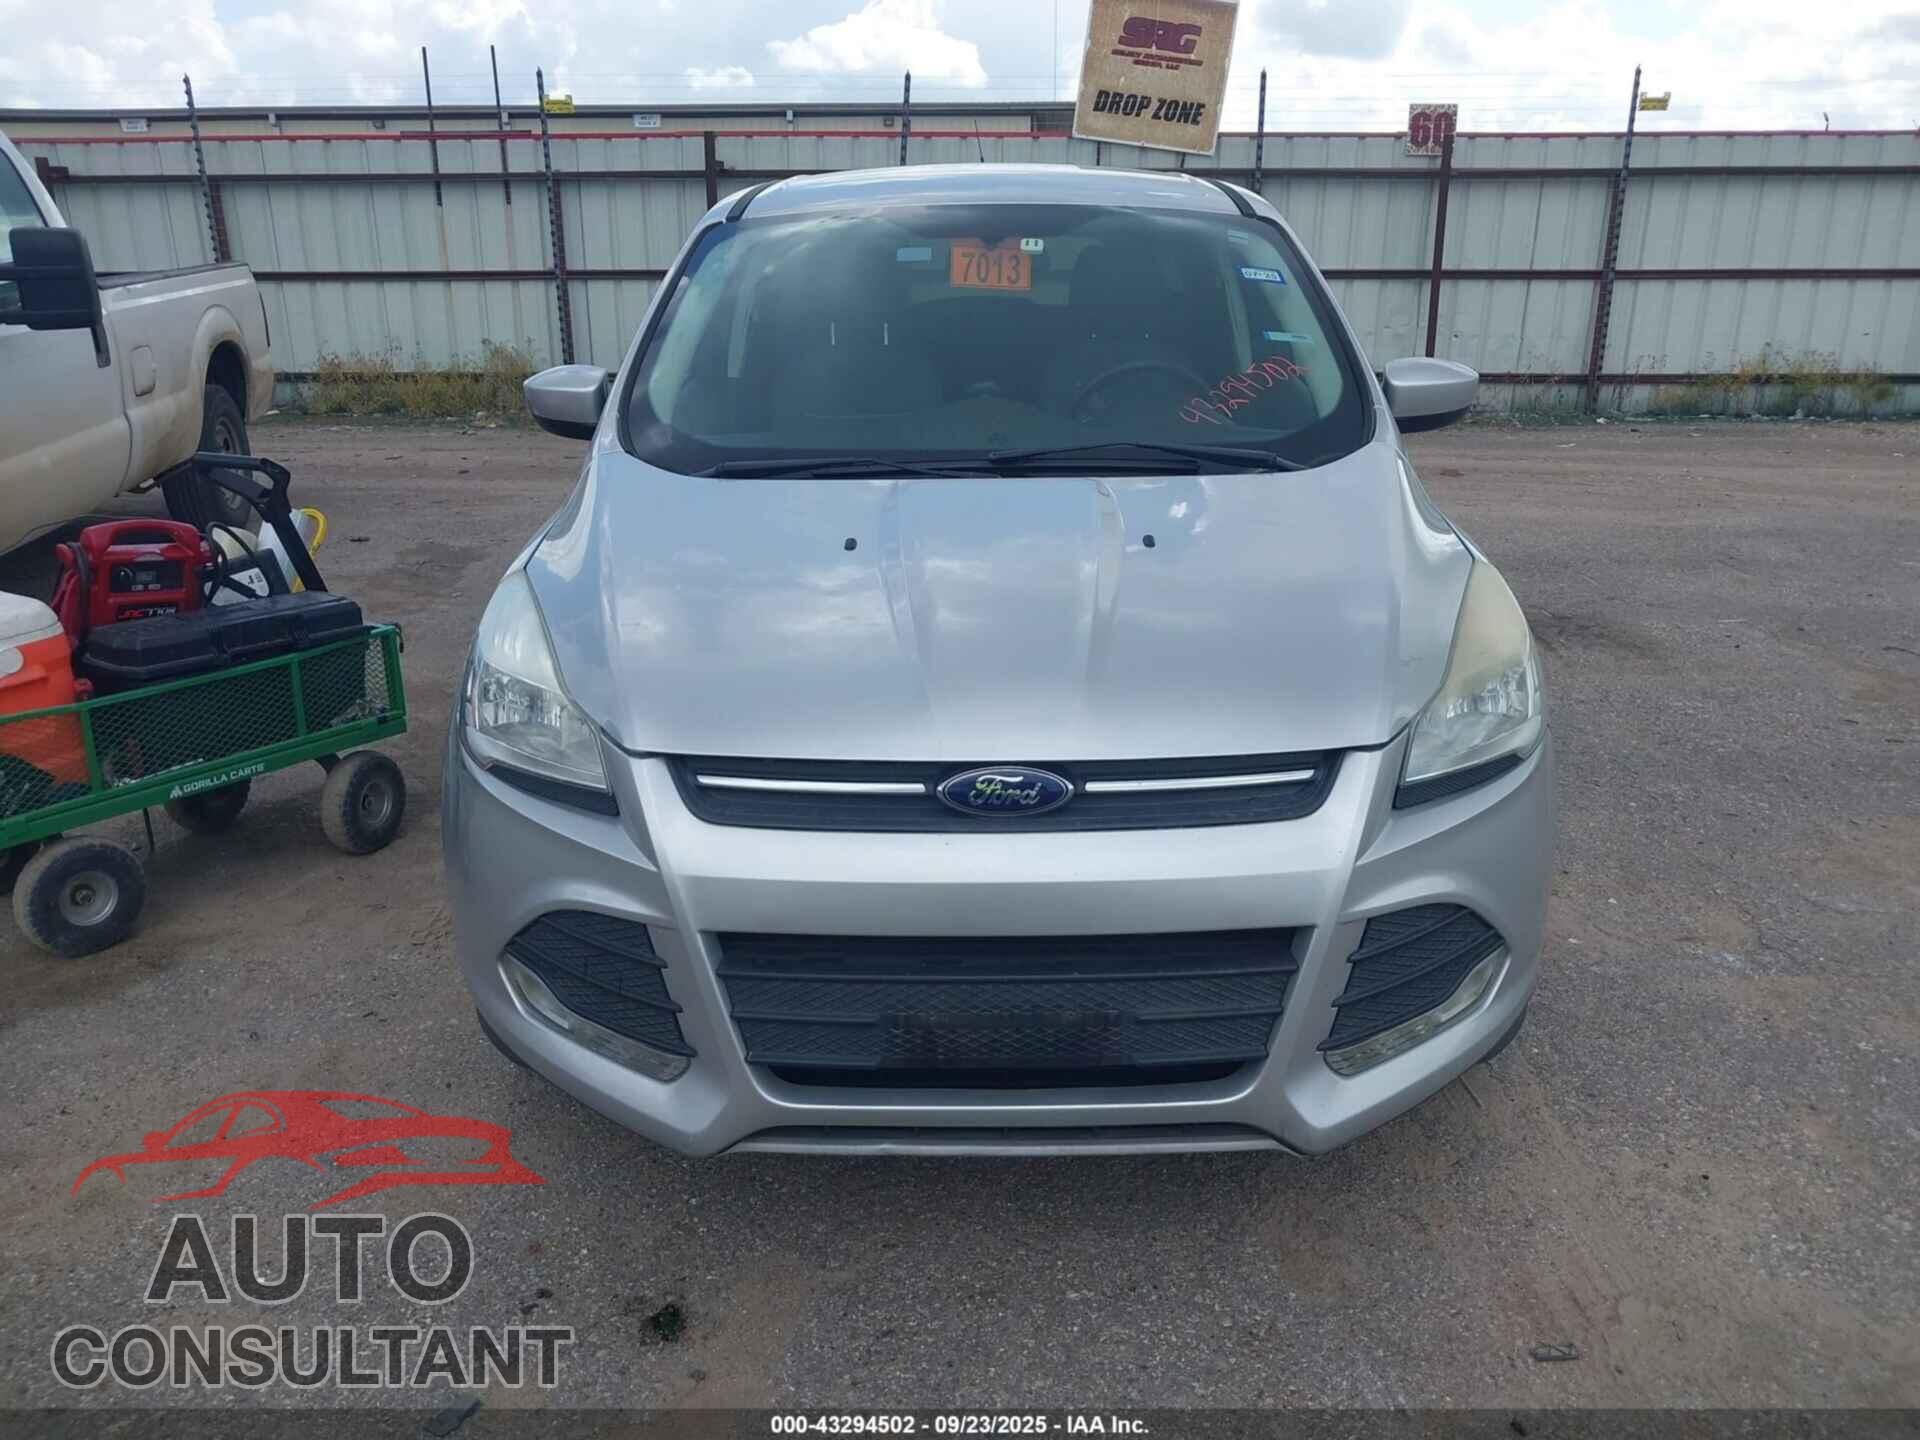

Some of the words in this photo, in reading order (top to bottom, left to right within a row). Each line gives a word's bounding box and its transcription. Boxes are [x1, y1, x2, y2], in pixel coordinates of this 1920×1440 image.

[1093, 89, 1151, 118] DROP
[1151, 98, 1206, 126] ZONE
[961, 252, 1021, 285] 7013
[1179, 356, 1312, 424] 43294502
[183, 774, 228, 793] GORILLA
[230, 763, 265, 780] CARTS
[968, 774, 1043, 805] Ford
